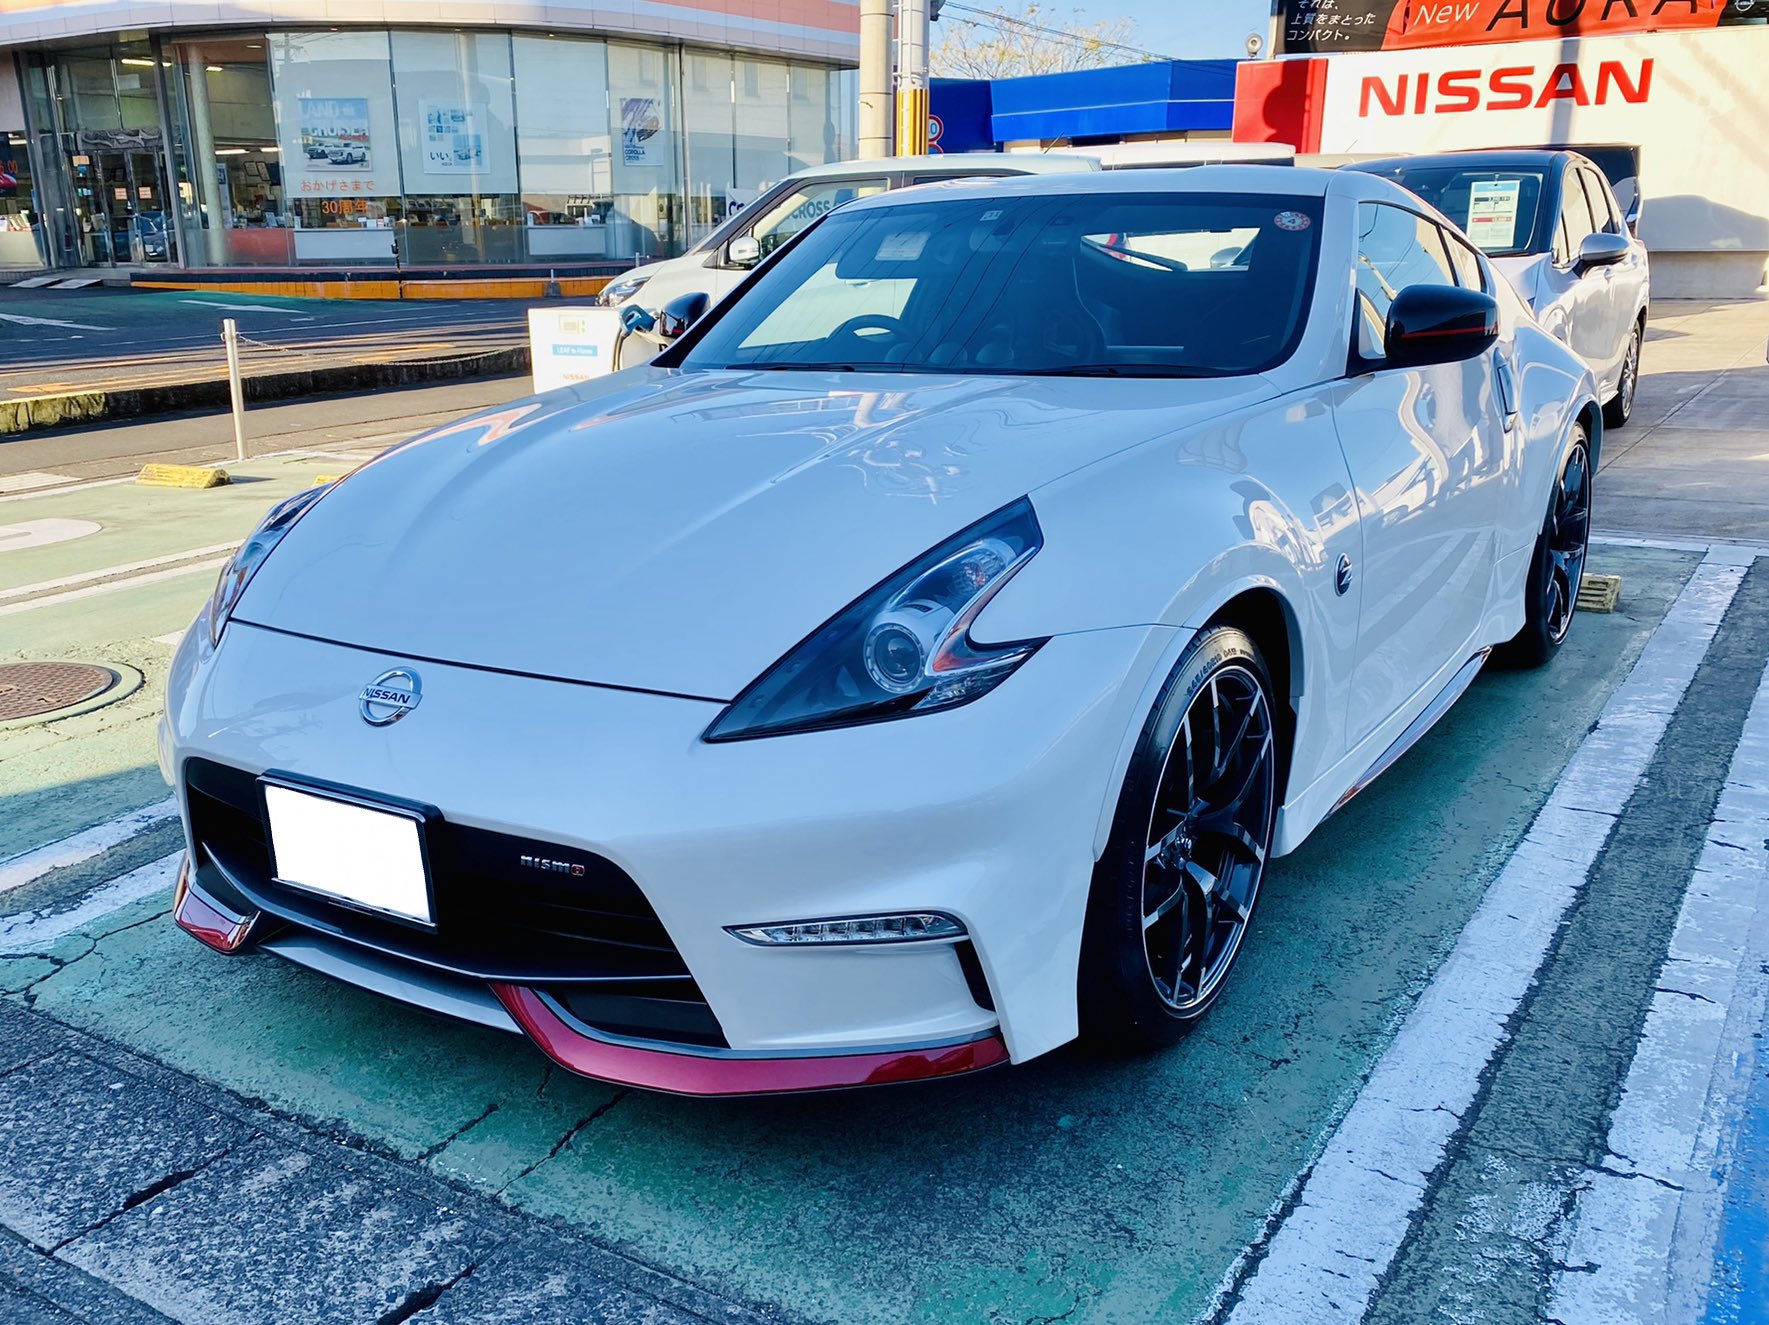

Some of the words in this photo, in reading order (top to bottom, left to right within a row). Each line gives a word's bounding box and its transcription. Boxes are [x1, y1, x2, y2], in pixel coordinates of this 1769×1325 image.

[1291, 12, 1377, 26] 上質をまとった
[1413, 2, 1480, 26] New
[1485, 0, 1700, 31] AU
[1287, 29, 1350, 41] コンパクト。
[1359, 58, 1655, 117] NISSAN
[301, 180, 375, 192] おかげさまで
[321, 200, 368, 214] 30周年
[362, 687, 411, 704] NISSAN
